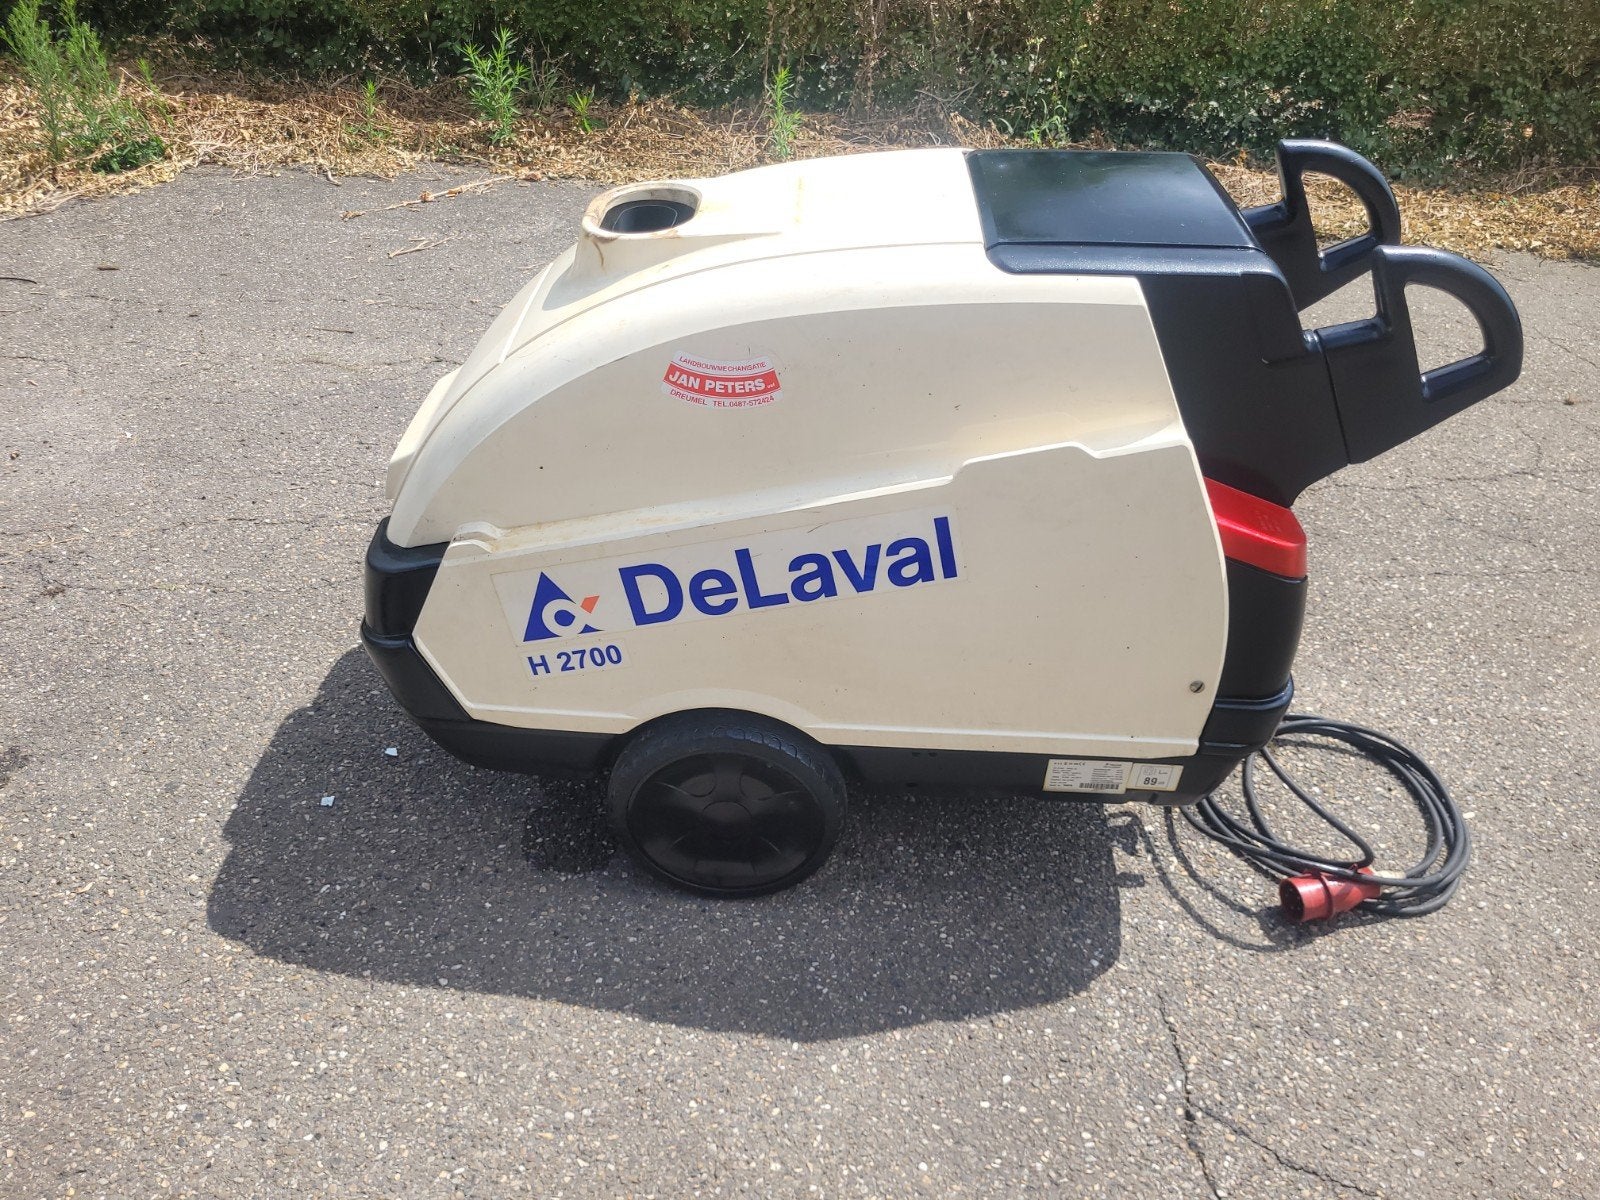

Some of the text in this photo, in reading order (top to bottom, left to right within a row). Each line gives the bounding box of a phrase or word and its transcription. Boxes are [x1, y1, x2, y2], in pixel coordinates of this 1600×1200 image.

[670, 372, 700, 390] JAN
[704, 378, 766, 393] PETERS
[670, 389, 708, 406] DREUMEL
[618, 516, 958, 626] DeLaval
[527, 644, 622, 675] H 2700
[1143, 777, 1158, 786] 89
